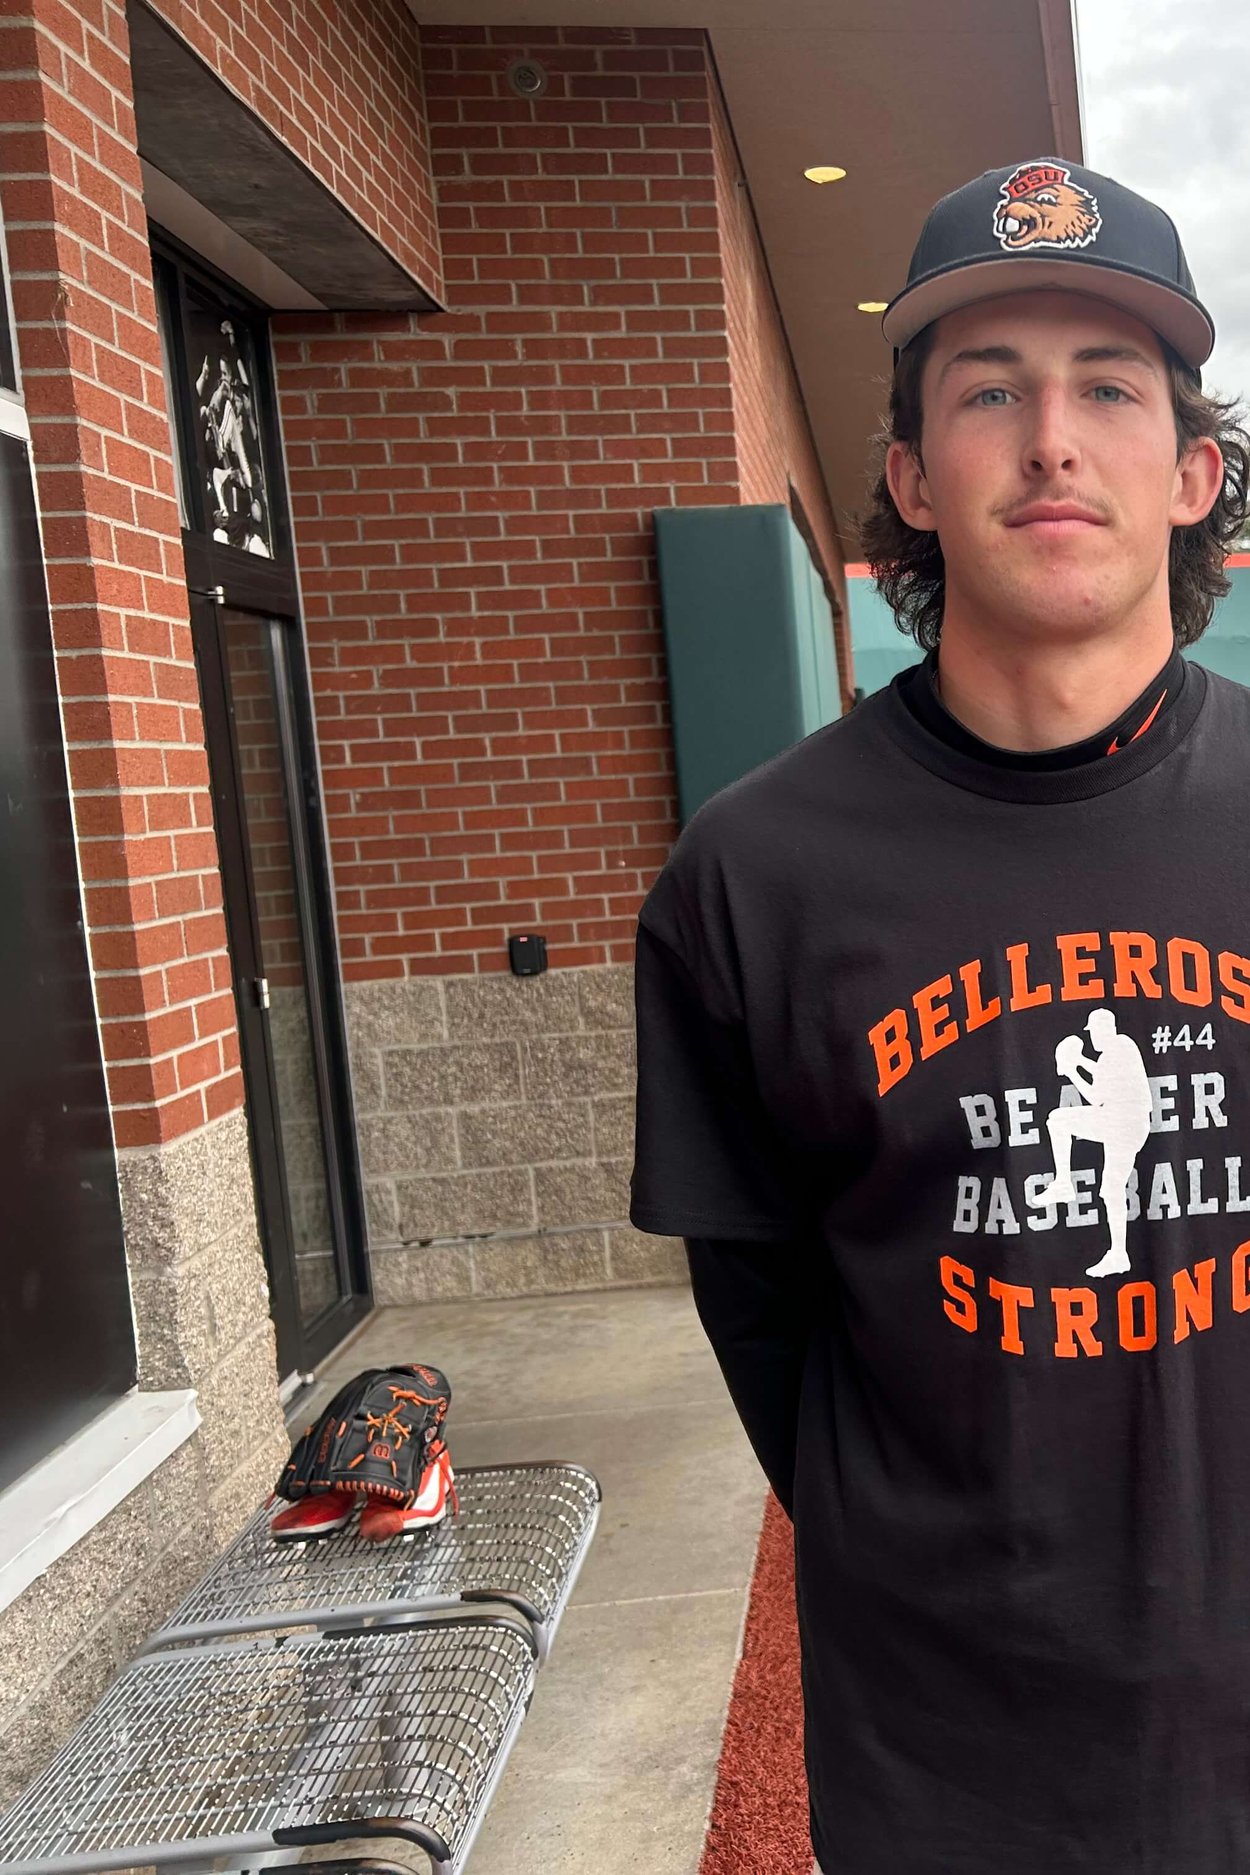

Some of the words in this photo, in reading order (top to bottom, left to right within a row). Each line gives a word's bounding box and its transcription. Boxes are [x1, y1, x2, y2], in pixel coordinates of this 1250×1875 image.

[1014, 170, 1060, 194] OSU
[1151, 1022, 1217, 1055] #44
[958, 1071, 1229, 1150] BEER
